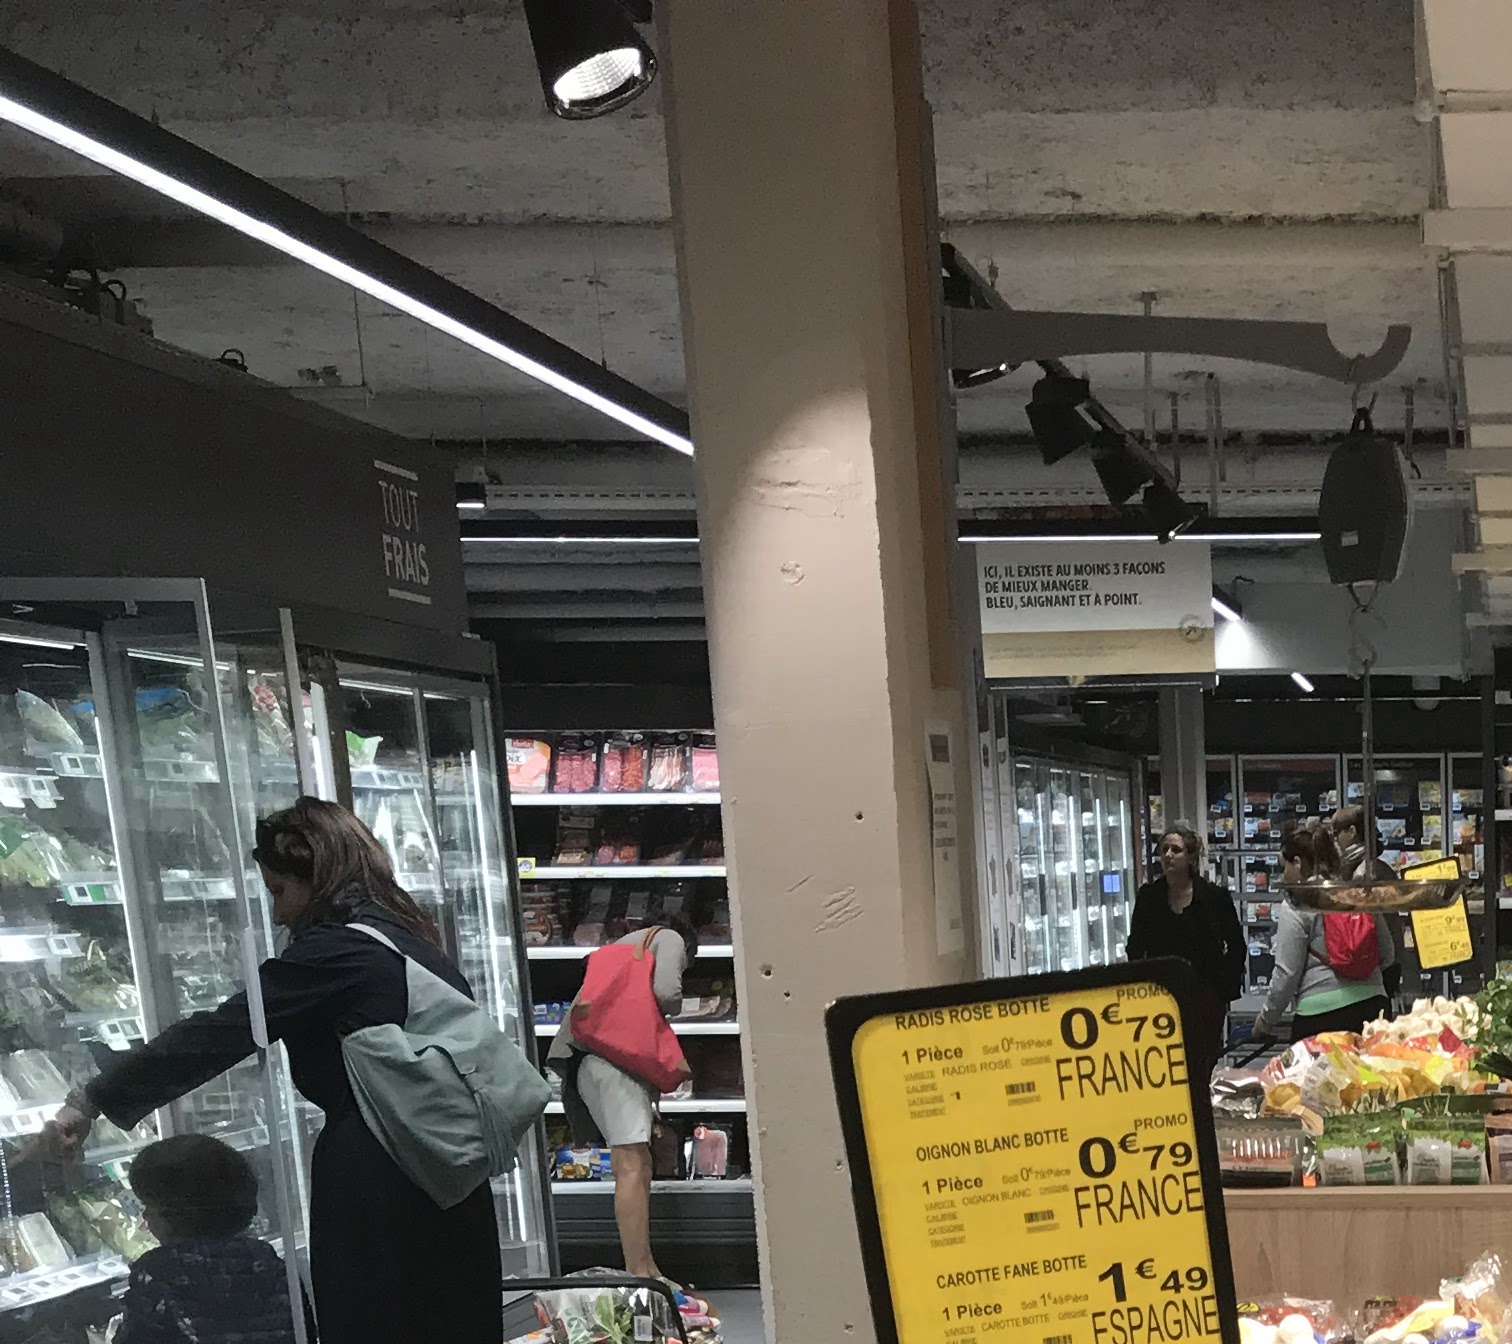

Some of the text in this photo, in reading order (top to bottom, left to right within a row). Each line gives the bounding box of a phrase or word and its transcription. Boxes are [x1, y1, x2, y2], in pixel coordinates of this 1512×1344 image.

[378, 480, 419, 533] TOUT
[382, 533, 430, 586] FRAIS
[984, 561, 1166, 580] ICI, IL EXISTE AU MOINS 3 FAÇONS
[985, 581, 999, 594] DE
[1002, 580, 1038, 593] MIEUX
[986, 596, 1018, 610] BLEU,
[1020, 594, 1077, 608] SAIGNANT
[1079, 594, 1091, 606] ET
[895, 998, 1051, 1030] RADIS ROSE BOTTE
[902, 1045, 963, 1065] 1 Pièce
[1056, 1043, 1188, 1101] FRANCE
[1134, 1113, 1188, 1131] PROMO
[916, 1128, 1069, 1161] OIGNON BLANC BOTTE
[922, 1175, 983, 1195] 1 Pièce
[1074, 1170, 1204, 1228] FRANCE
[936, 1255, 1087, 1289] CAROTTE FANE BOTTE
[943, 1301, 1003, 1321] 1 Pièce
